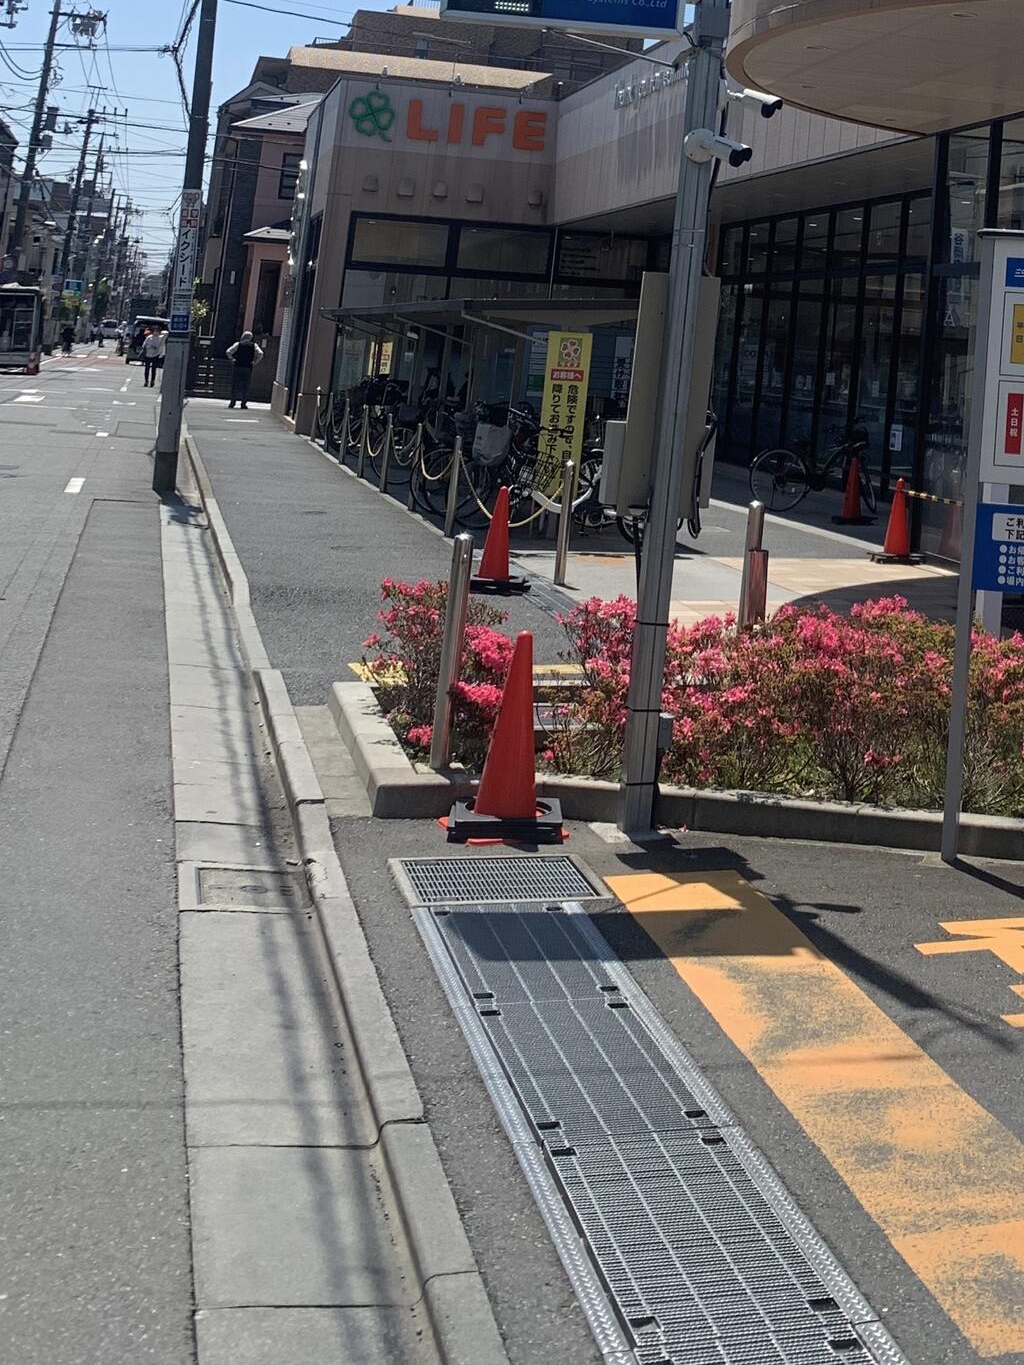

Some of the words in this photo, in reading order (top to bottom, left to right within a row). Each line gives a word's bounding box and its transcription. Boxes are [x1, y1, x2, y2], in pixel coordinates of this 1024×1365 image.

[406, 99, 547, 152] LIFE
[1016, 322, 1024, 344] 平日
[1010, 408, 1019, 438] 土日祝
